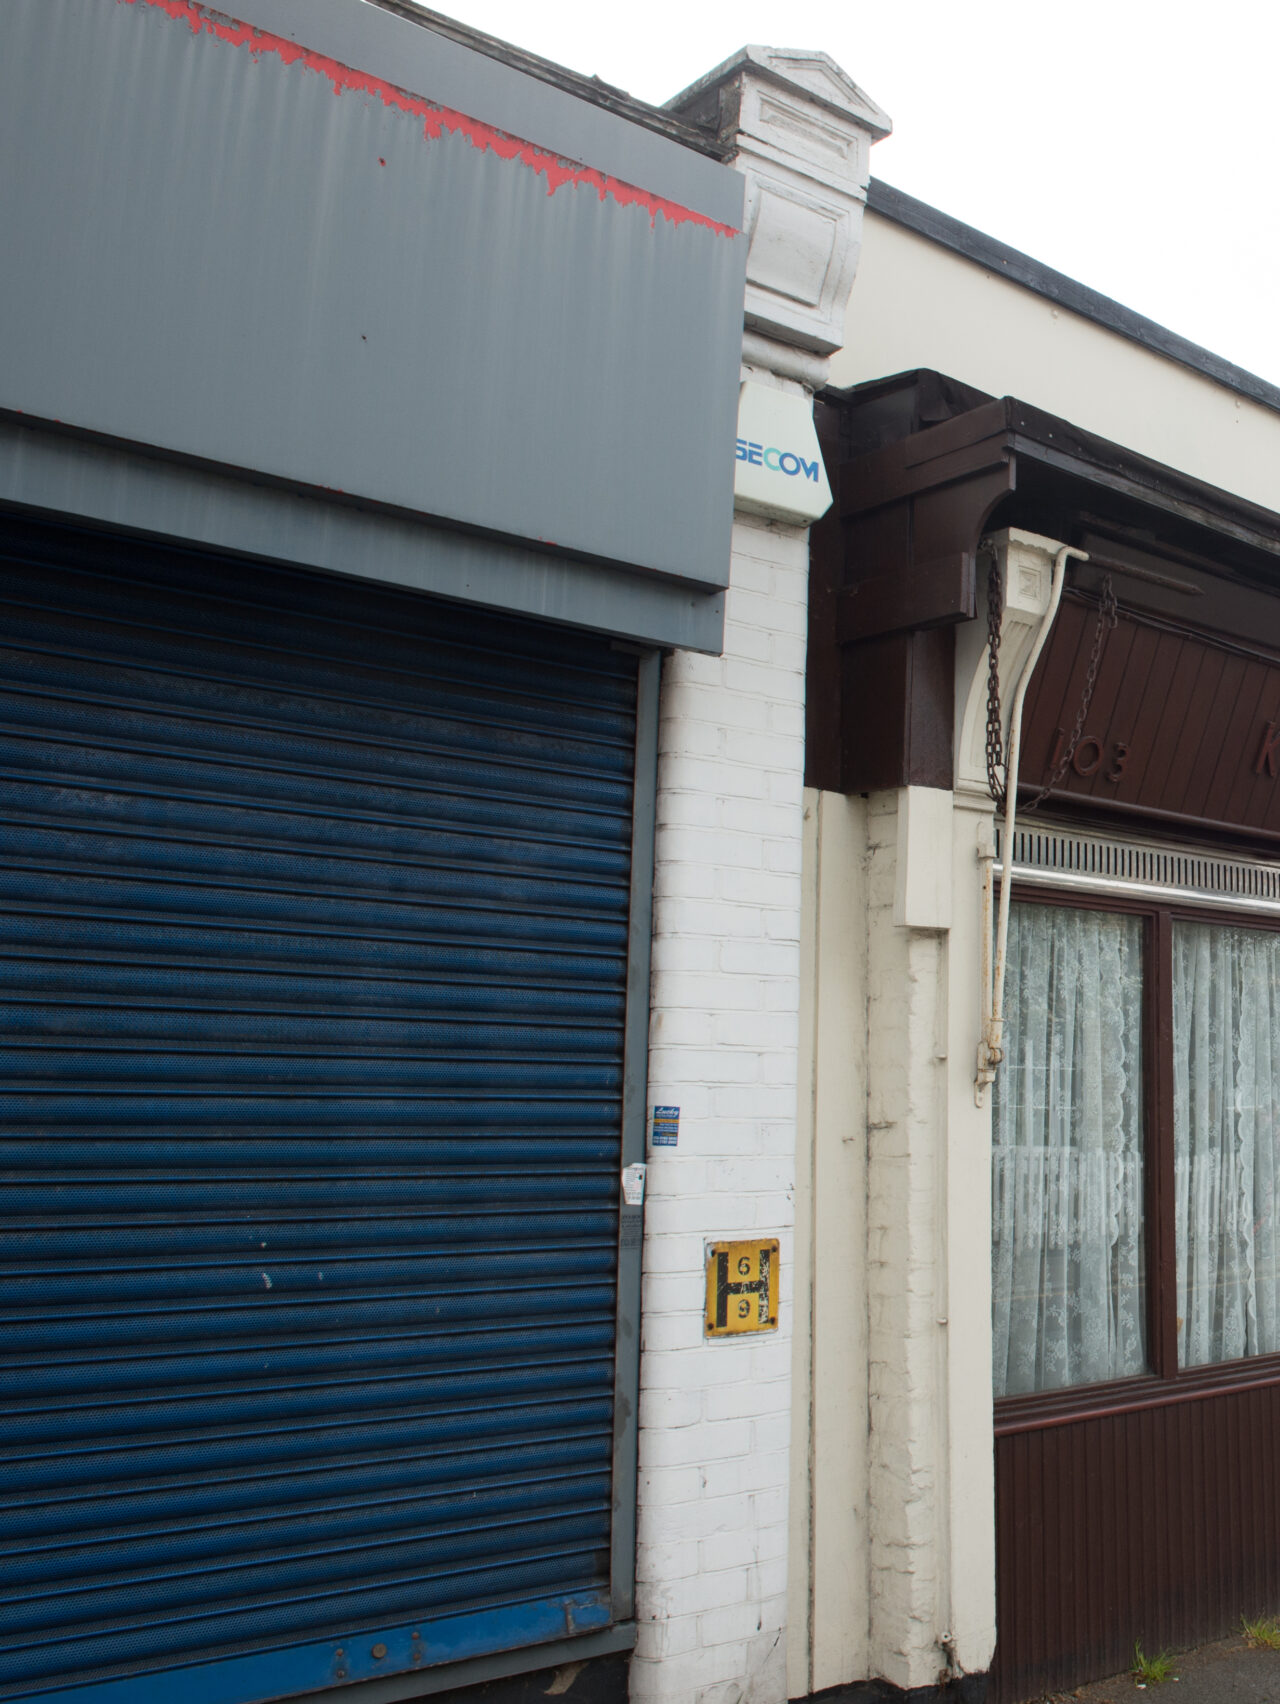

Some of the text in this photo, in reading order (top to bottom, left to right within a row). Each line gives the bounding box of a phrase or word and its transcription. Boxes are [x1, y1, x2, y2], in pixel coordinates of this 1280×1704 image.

[735, 438, 819, 483] SECOM
[1049, 726, 1131, 783] 103
[737, 1256, 750, 1275] 6
[738, 1299, 750, 1319] 9
